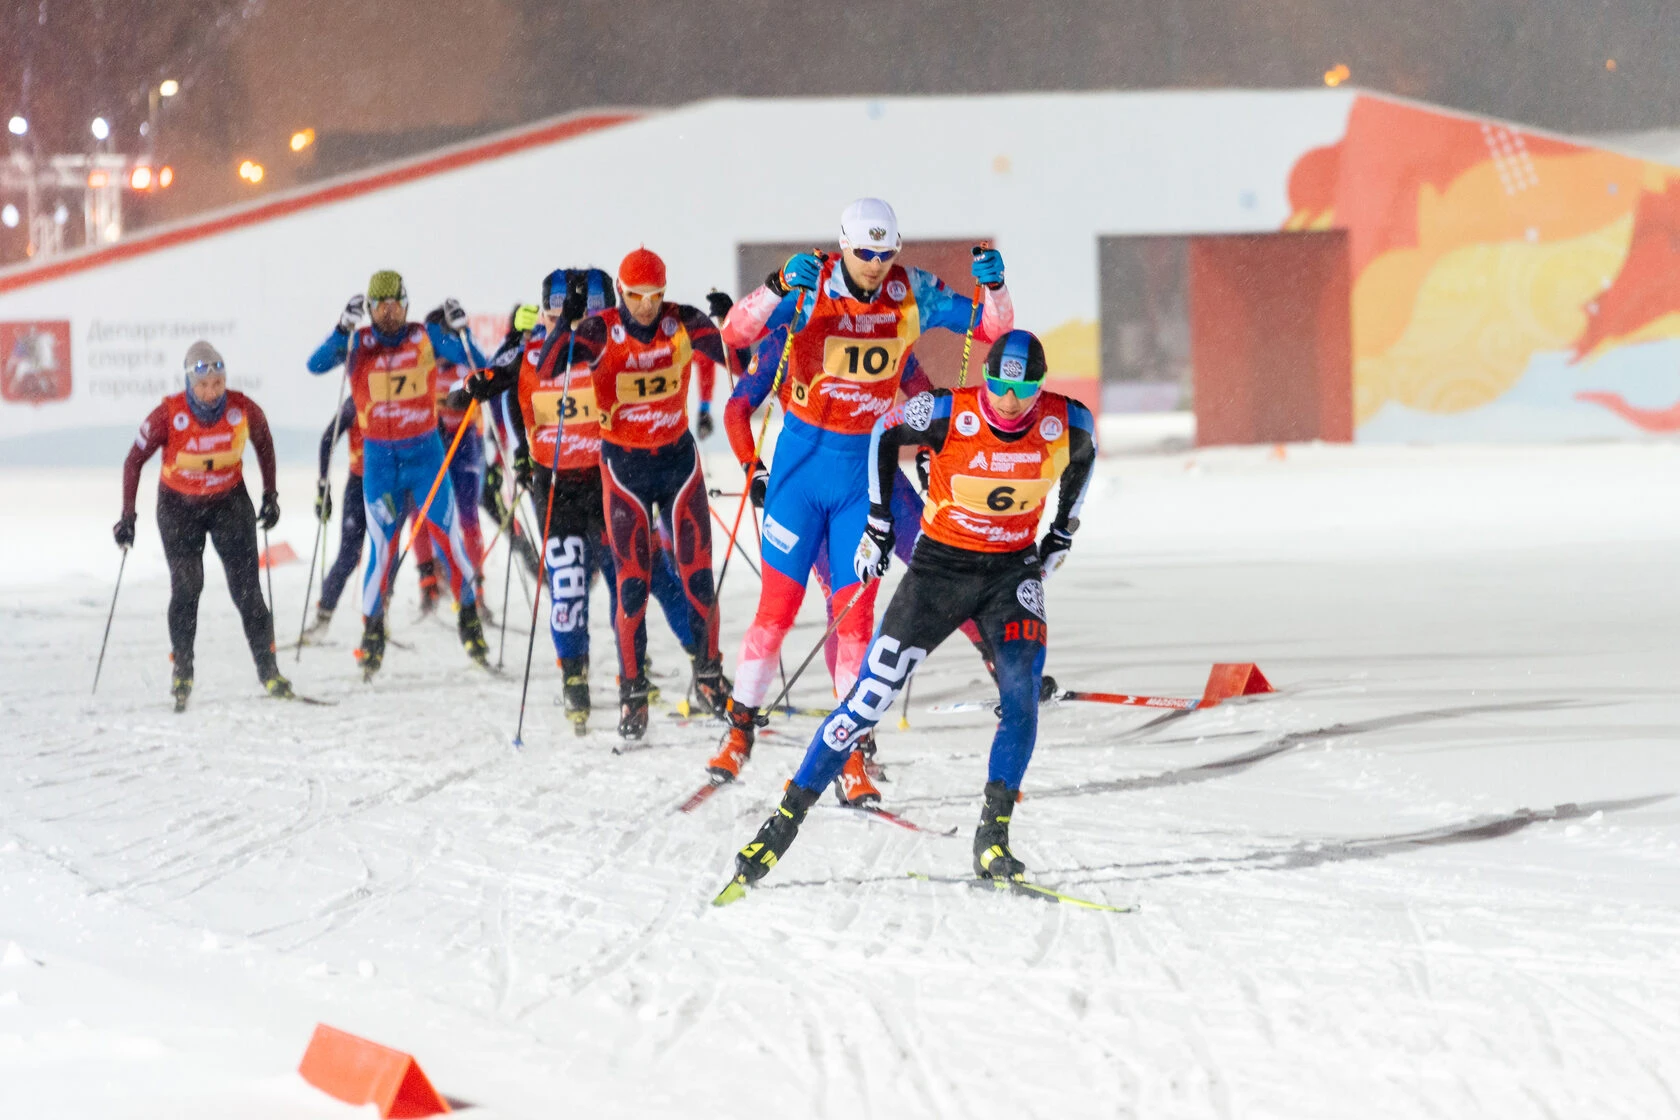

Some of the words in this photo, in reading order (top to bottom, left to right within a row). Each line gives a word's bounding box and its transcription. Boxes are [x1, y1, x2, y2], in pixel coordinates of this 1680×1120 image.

[844, 346, 889, 375] 10
[391, 376, 407, 394] 7
[634, 376, 667, 397] 12
[556, 396, 578, 418] 8
[583, 405, 589, 417] 1
[203, 459, 214, 471] 1
[986, 486, 1016, 511] 6
